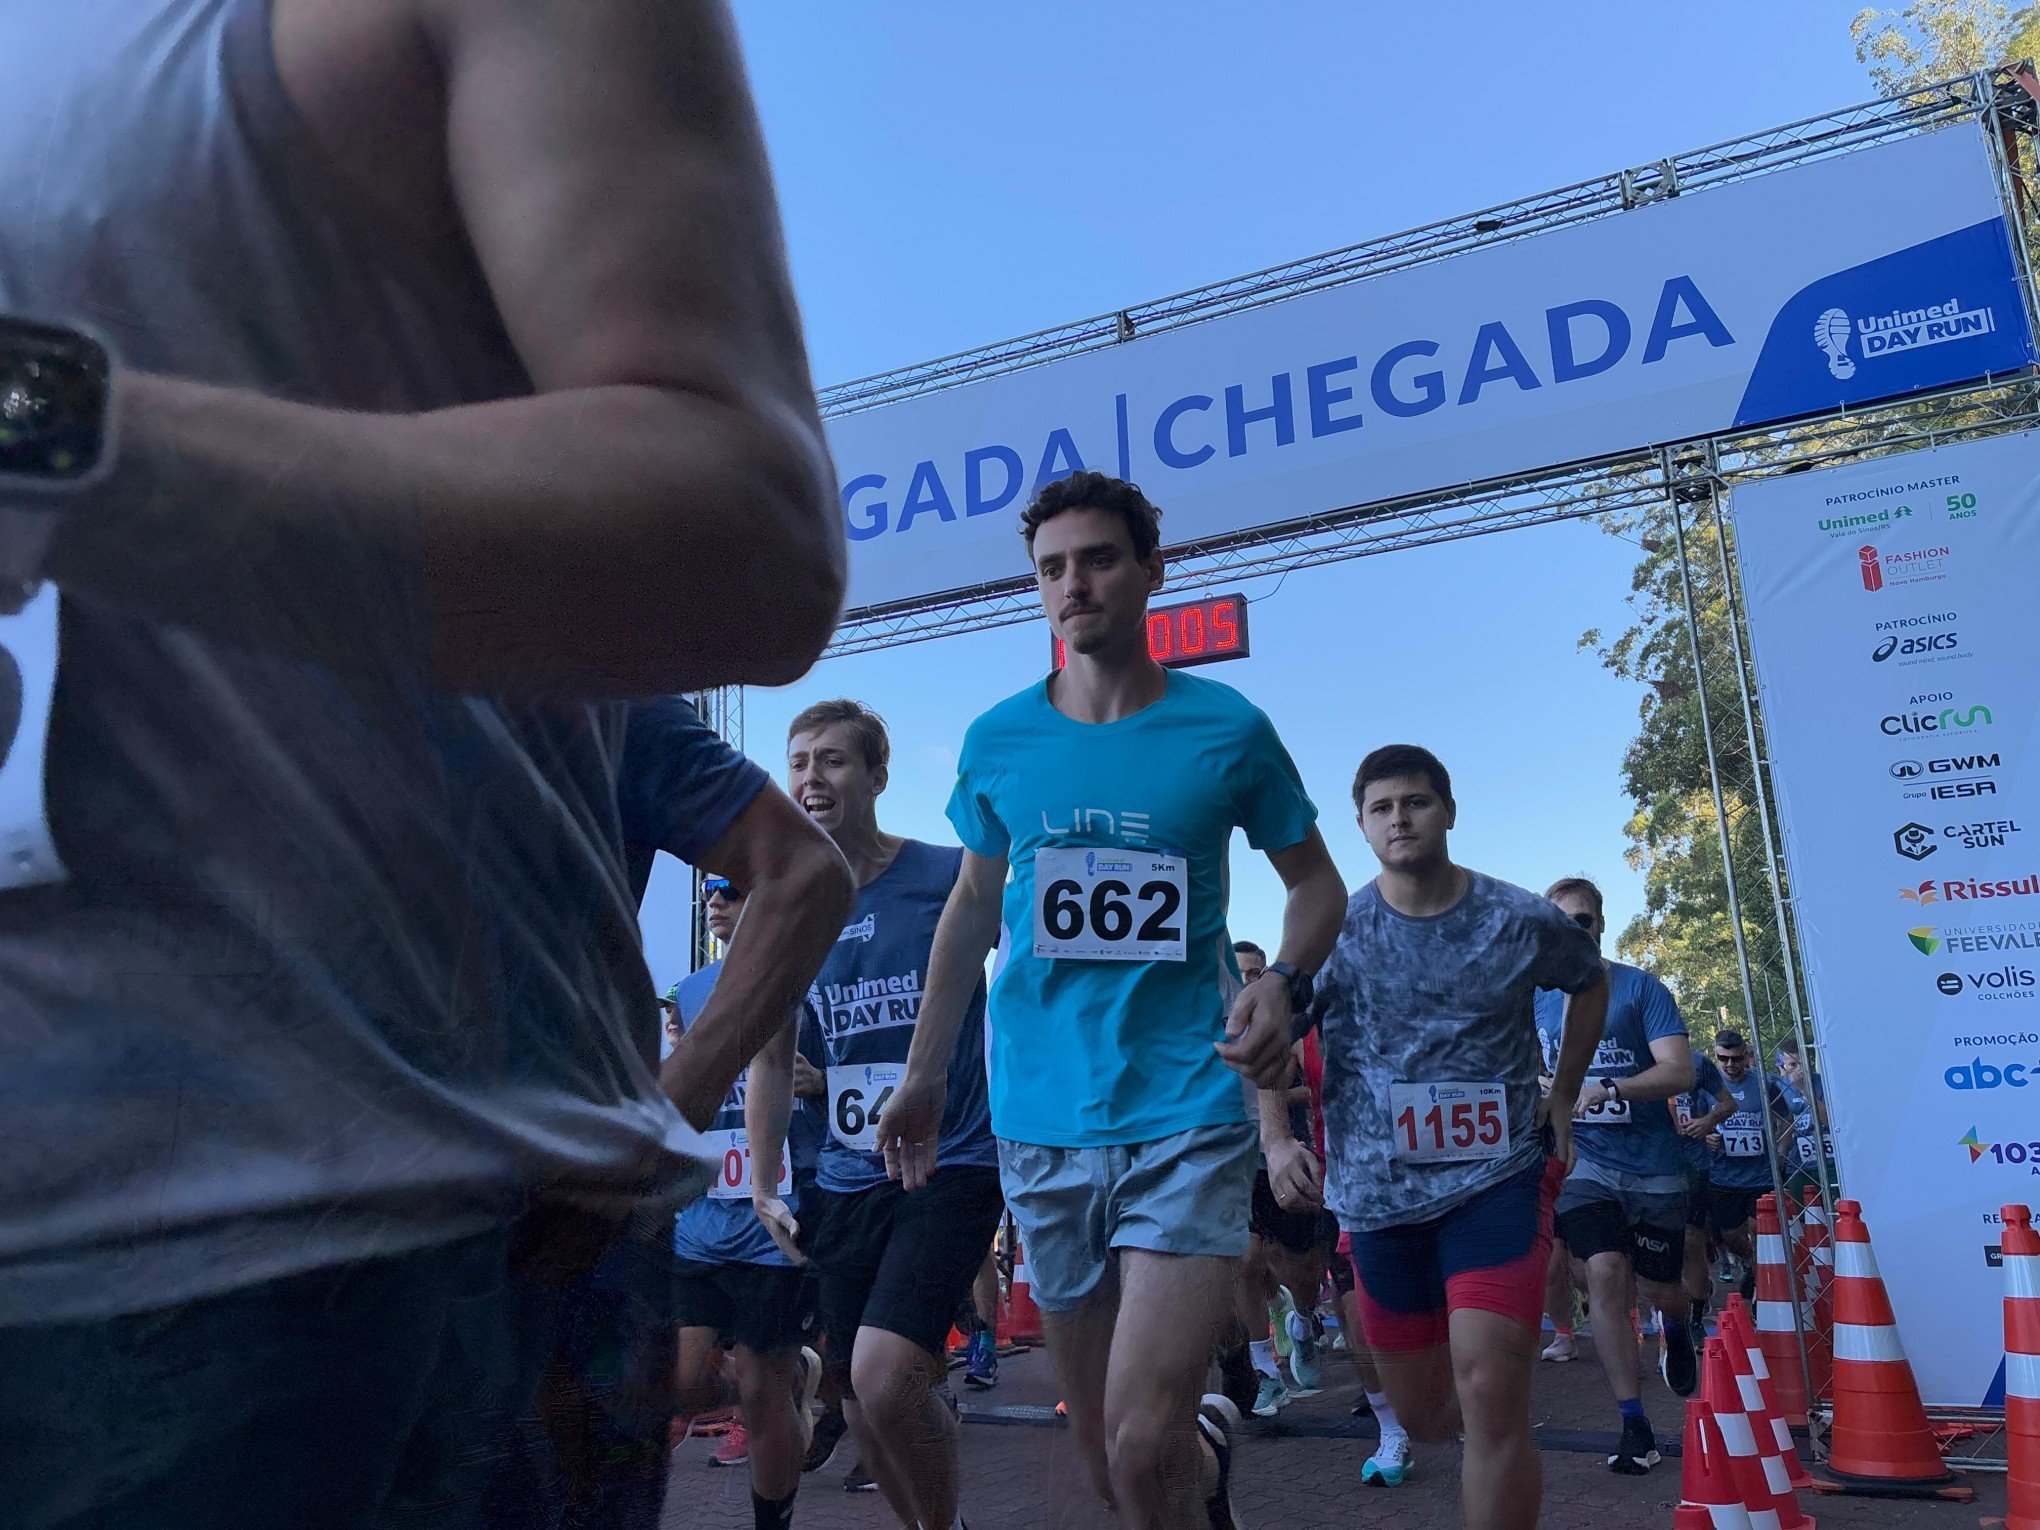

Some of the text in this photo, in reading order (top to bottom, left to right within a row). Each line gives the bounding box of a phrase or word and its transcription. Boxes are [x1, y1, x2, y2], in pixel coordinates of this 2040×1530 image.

[1857, 298, 1960, 334] Unimed
[1867, 314, 1983, 354] DAY RUN
[1153, 275, 1736, 469] CHEGADA
[1825, 475, 1961, 506] PATROCÍNIO MASTER
[1946, 492, 1977, 512] 50
[1818, 508, 1890, 532] Unimed
[1948, 509, 1977, 521] ANOS
[1829, 530, 1846, 539] Vale
[1885, 546, 1950, 565] FASHION
[1887, 558, 1944, 576] OUTLET
[1909, 572, 1947, 584] Hamburgo
[1875, 611, 1957, 631] PATROCÍNIO
[1898, 659, 1918, 667] sound
[1937, 653, 1956, 662] sound
[1957, 651, 1974, 660] body
[1909, 691, 1953, 706] APOIO
[1928, 753, 2001, 773] GWM
[1903, 781, 1997, 801] Grupo IESA
[1042, 808, 1150, 838] LINE
[1943, 820, 2022, 838] CARTEL
[1963, 834, 2005, 849] SUN
[1151, 863, 1176, 872] 5Km
[1943, 874, 2040, 900] Rissul
[1043, 879, 1181, 942] 662
[849, 924, 873, 936] SINOS
[1944, 922, 2040, 936] UNIVERSIDAD
[1967, 965, 2036, 989] volis
[824, 970, 919, 1005] Unimed
[1978, 990, 2035, 1000] COLCHÕES
[833, 1002, 884, 1032] DAY
[1954, 1032, 2039, 1047] PROMOÇÃO
[1599, 1051, 1631, 1065] RUN
[1397, 1101, 1502, 1151] 1155
[1727, 1119, 1747, 1127] DAY
[1725, 1136, 1761, 1152] 713
[1801, 1140, 1833, 1157] 56
